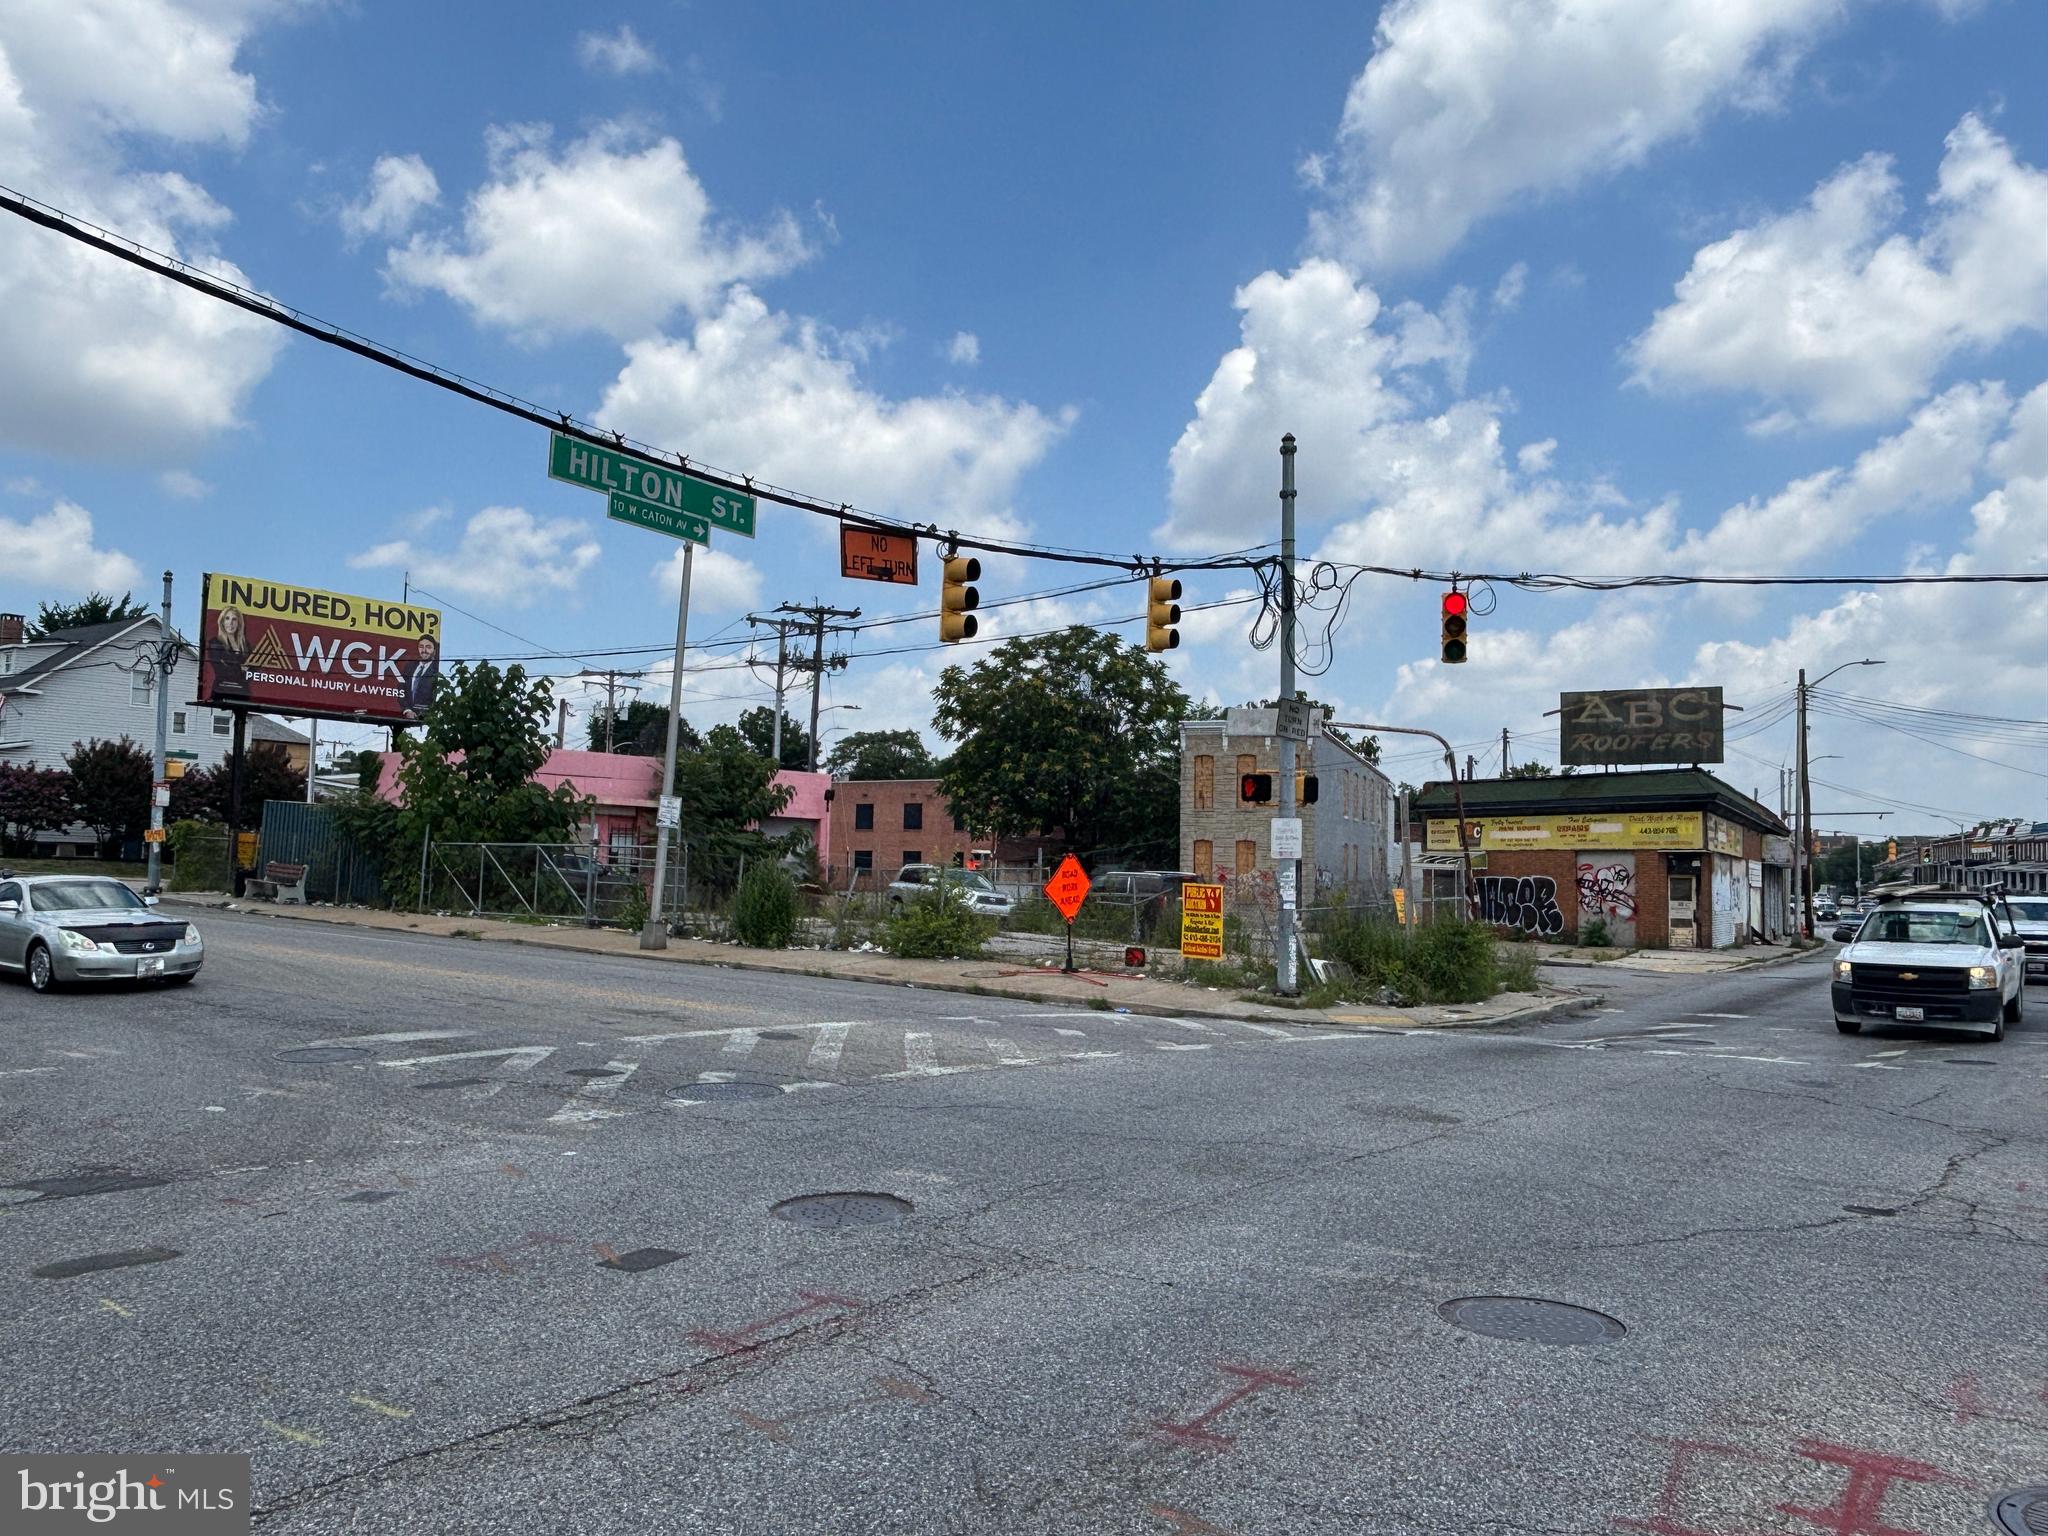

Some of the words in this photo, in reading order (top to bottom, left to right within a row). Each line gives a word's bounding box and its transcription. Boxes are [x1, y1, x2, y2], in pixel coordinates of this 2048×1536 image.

[569, 447, 683, 508] HILTON
[711, 496, 745, 524] ST.
[629, 505, 638, 517] W
[642, 509, 673, 527] CATON
[675, 520, 688, 531] AV
[871, 536, 888, 552] NO
[221, 579, 356, 628] INJURED,
[364, 603, 439, 635] HON?
[291, 632, 407, 684] WGK
[245, 671, 308, 687] PERSONAL
[311, 680, 351, 693] INJURY
[353, 683, 406, 698] LAWYERS
[1289, 703, 1300, 714] NO
[1571, 691, 1713, 730] ABC
[1570, 731, 1715, 753] ROOFERS
